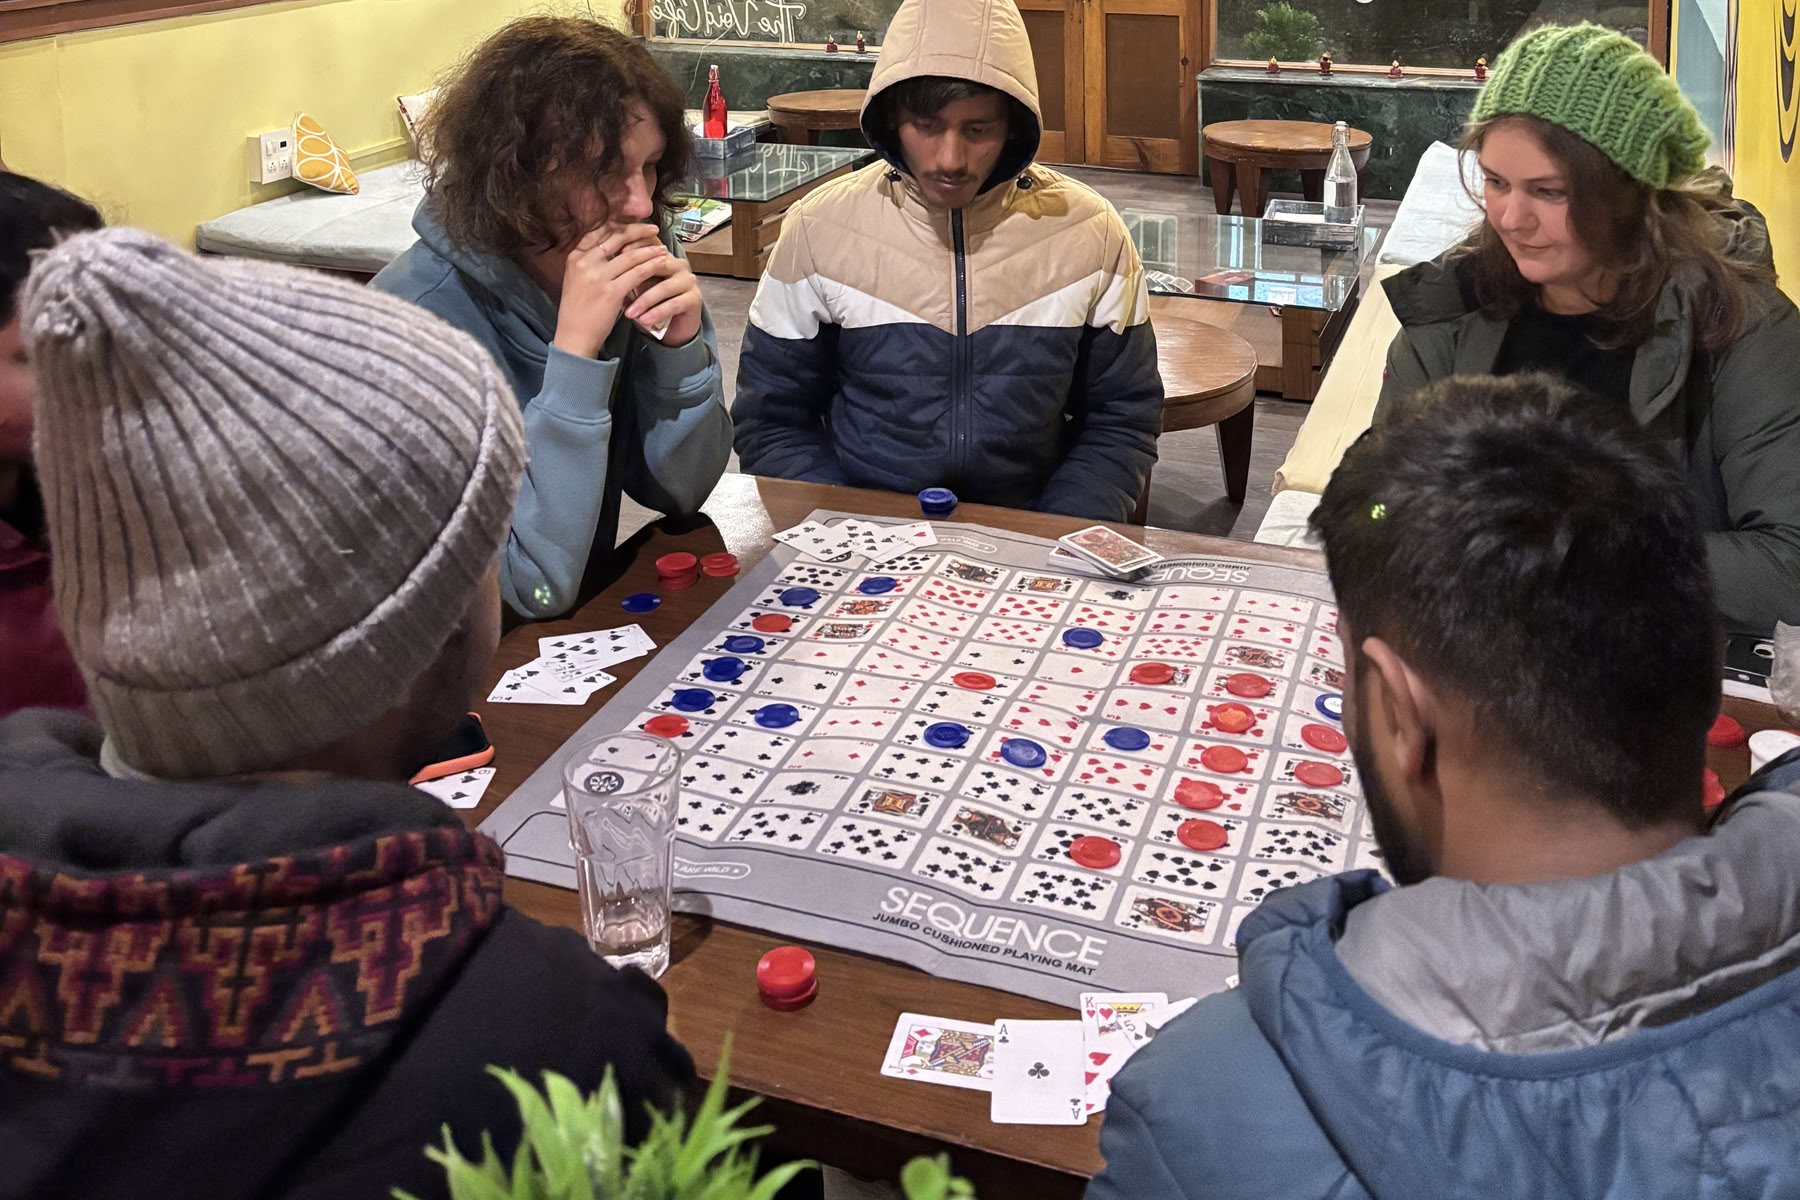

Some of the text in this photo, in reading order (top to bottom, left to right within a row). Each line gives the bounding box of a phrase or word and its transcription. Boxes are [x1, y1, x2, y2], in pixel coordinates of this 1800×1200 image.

[880, 886, 1107, 966] SEQUENCE
[872, 912, 1097, 977] JUMBO CUSHIONED PLAYING MAT
[1085, 997, 1094, 1008] K
[999, 1024, 1009, 1035] A
[1125, 1020, 1136, 1031] 5
